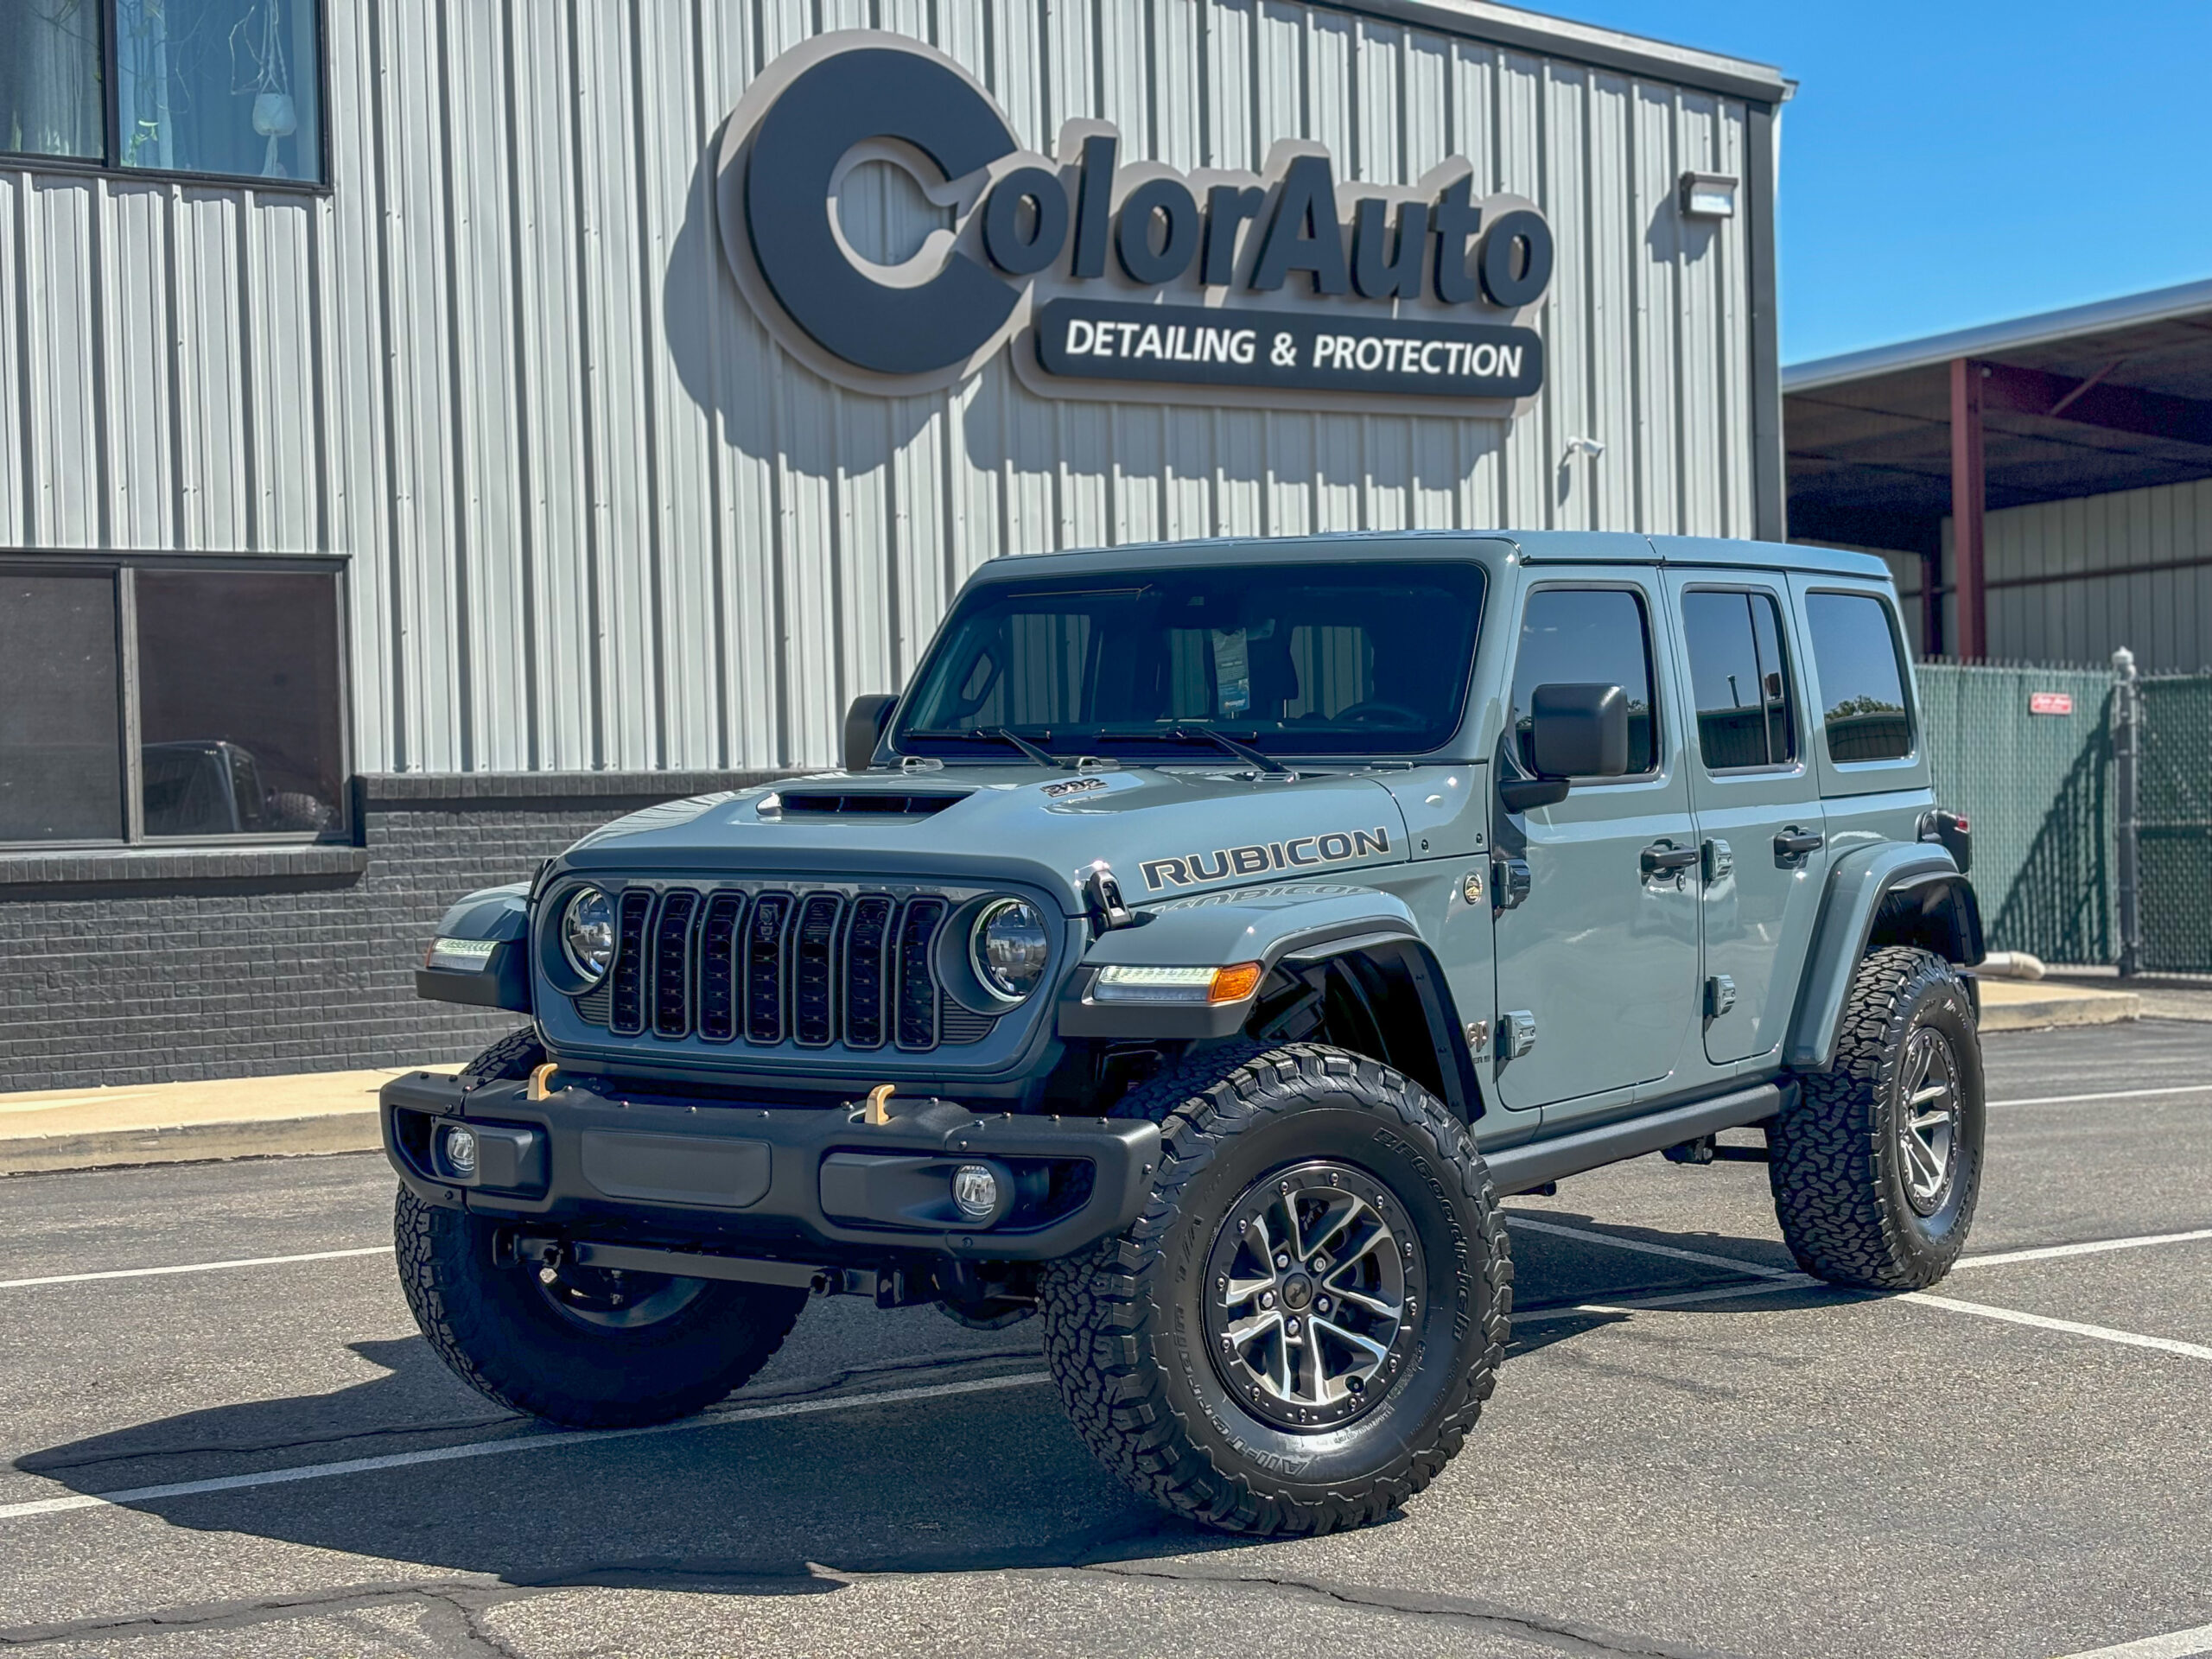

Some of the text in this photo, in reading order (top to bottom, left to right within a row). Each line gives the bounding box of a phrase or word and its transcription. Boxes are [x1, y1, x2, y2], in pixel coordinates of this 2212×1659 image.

[745, 46, 1554, 376] ColorAuto
[1065, 319, 1522, 378] DETAILING & PROTECTION
[1139, 826, 1390, 892] RUBICON
